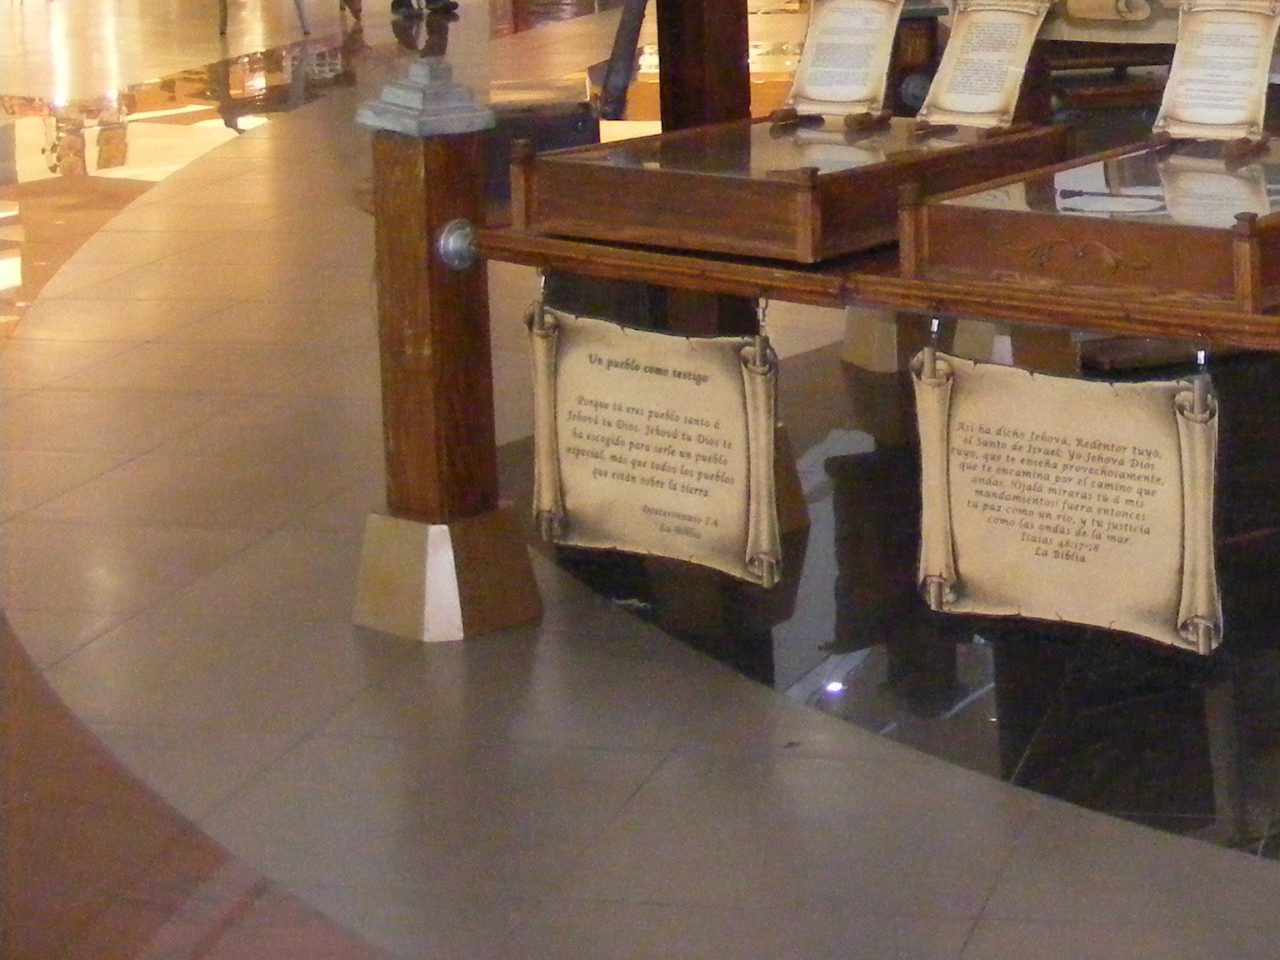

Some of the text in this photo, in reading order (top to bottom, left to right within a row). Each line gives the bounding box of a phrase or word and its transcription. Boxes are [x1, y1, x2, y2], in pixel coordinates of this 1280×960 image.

[606, 357, 641, 372] pueblo
[643, 364, 670, 377] como
[592, 467, 608, 479] que
[668, 479, 678, 491] la
[681, 483, 709, 498] tierra
[630, 457, 647, 470] que
[650, 460, 677, 475] todos
[680, 464, 694, 478] los
[697, 469, 736, 485] pueblos
[966, 500, 979, 509] tu
[982, 503, 1003, 513] paz
[1006, 506, 1035, 517] como
[1038, 511, 1052, 521] un
[1080, 519, 1087, 529] y
[1091, 518, 1103, 528] tu
[1106, 520, 1151, 536] justicia
[987, 516, 1016, 527] como
[1019, 518, 1035, 530] las
[1038, 523, 1071, 536] ondas
[1075, 527, 1087, 538] de
[1091, 529, 1102, 541] la
[1034, 546, 1087, 564] La Biblia
